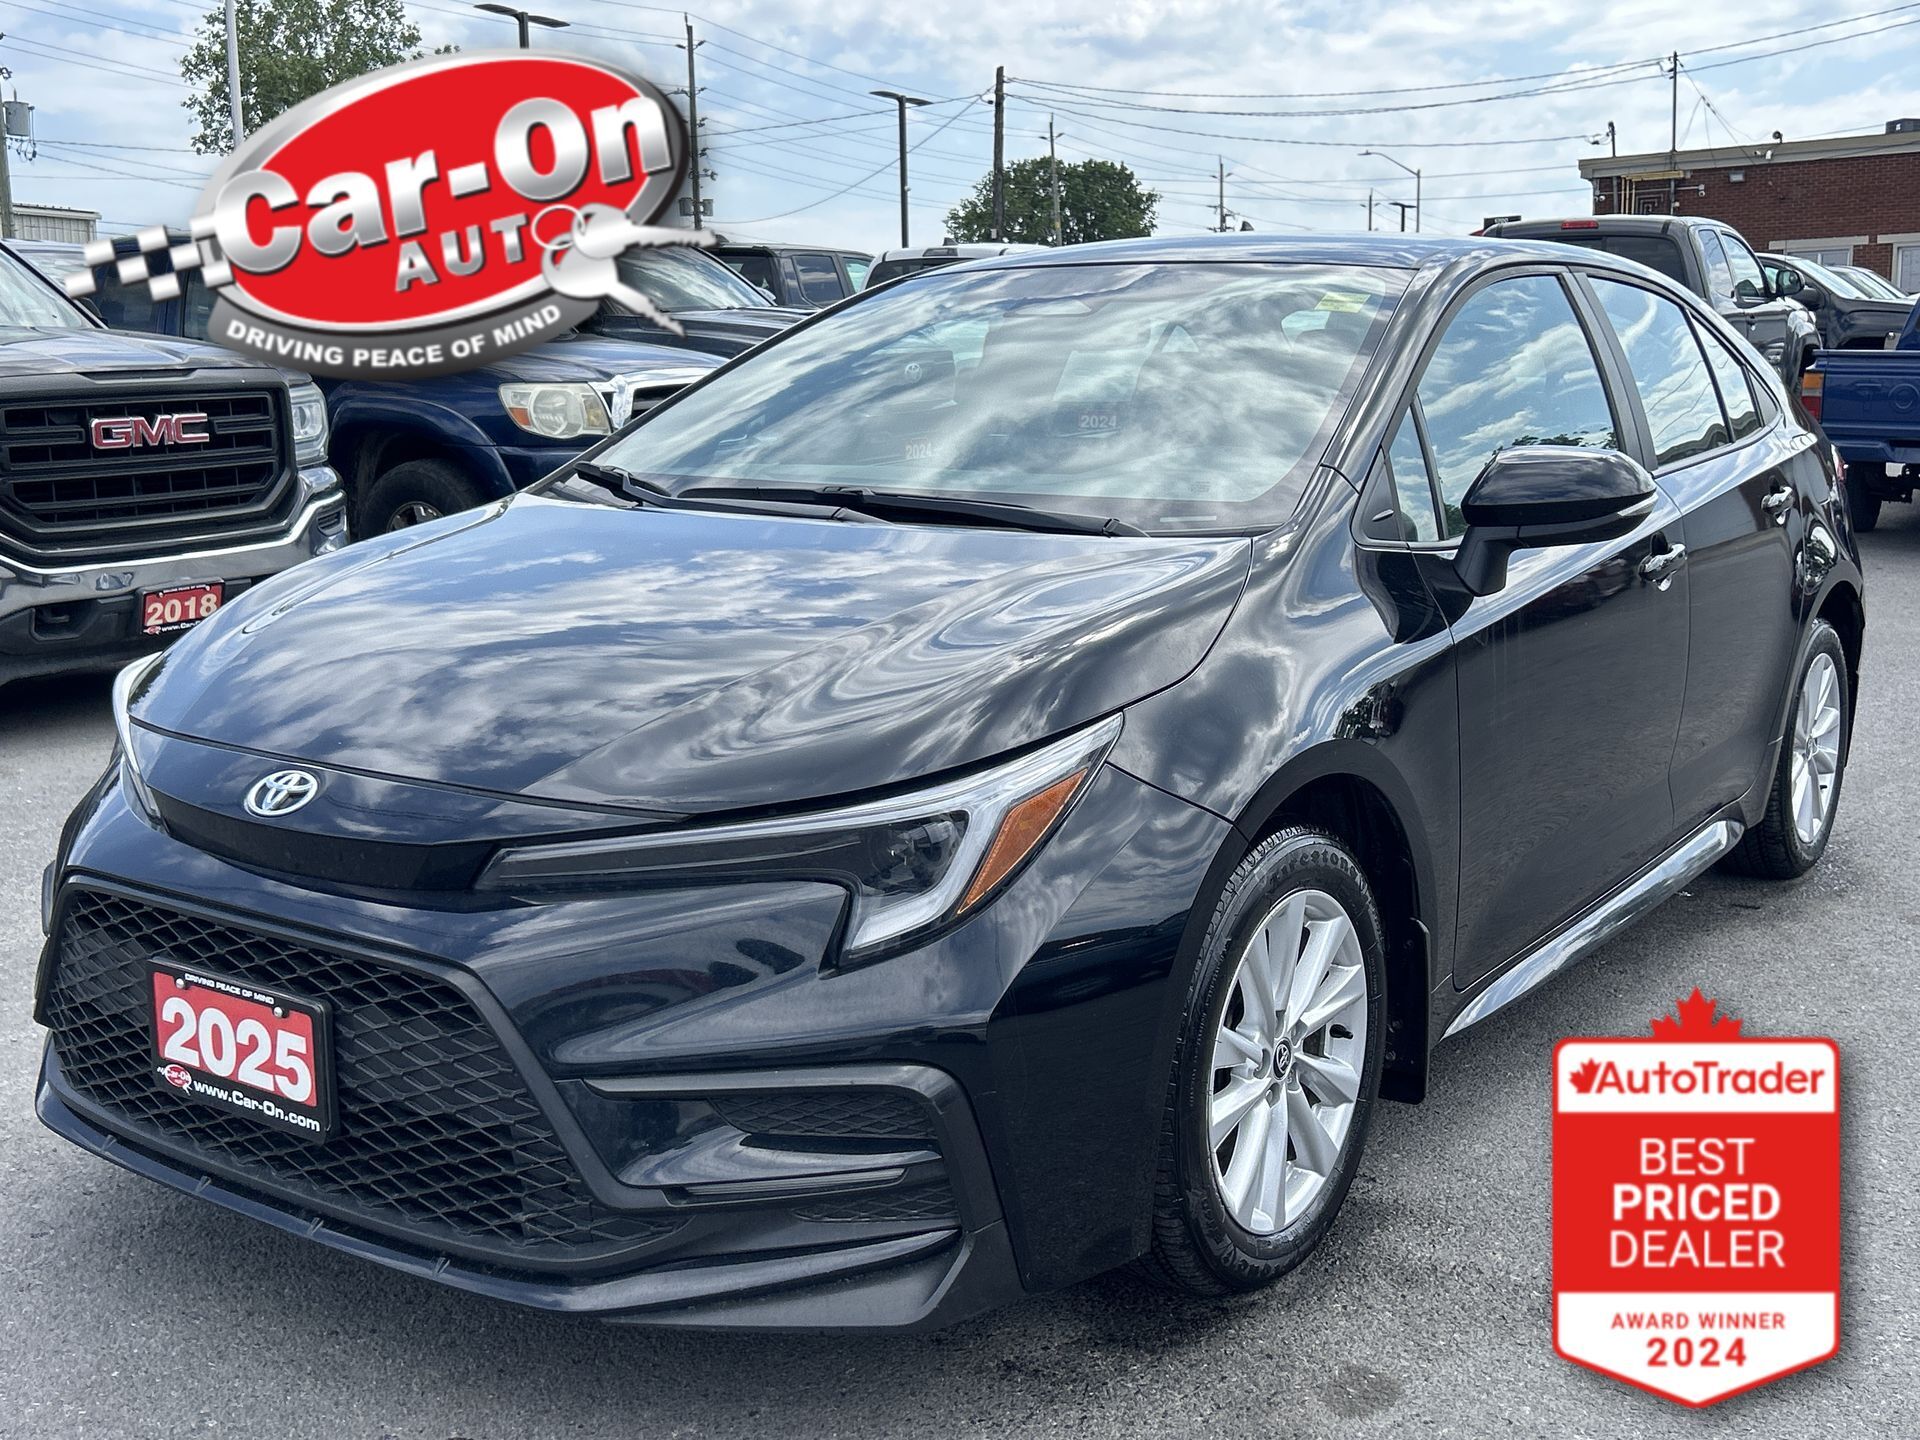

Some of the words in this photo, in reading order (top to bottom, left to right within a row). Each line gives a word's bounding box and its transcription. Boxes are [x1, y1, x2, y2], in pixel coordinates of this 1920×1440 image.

[91, 413, 210, 449] GMC
[1081, 415, 1117, 428] 2024
[146, 593, 217, 627] 2018
[184, 973, 216, 988] DRIVING
[216, 982, 241, 995] PEACE
[241, 988, 253, 998] OF
[253, 992, 275, 1005] MIND
[161, 996, 312, 1102] 2025
[193, 1080, 321, 1132] www.Car-On.com
